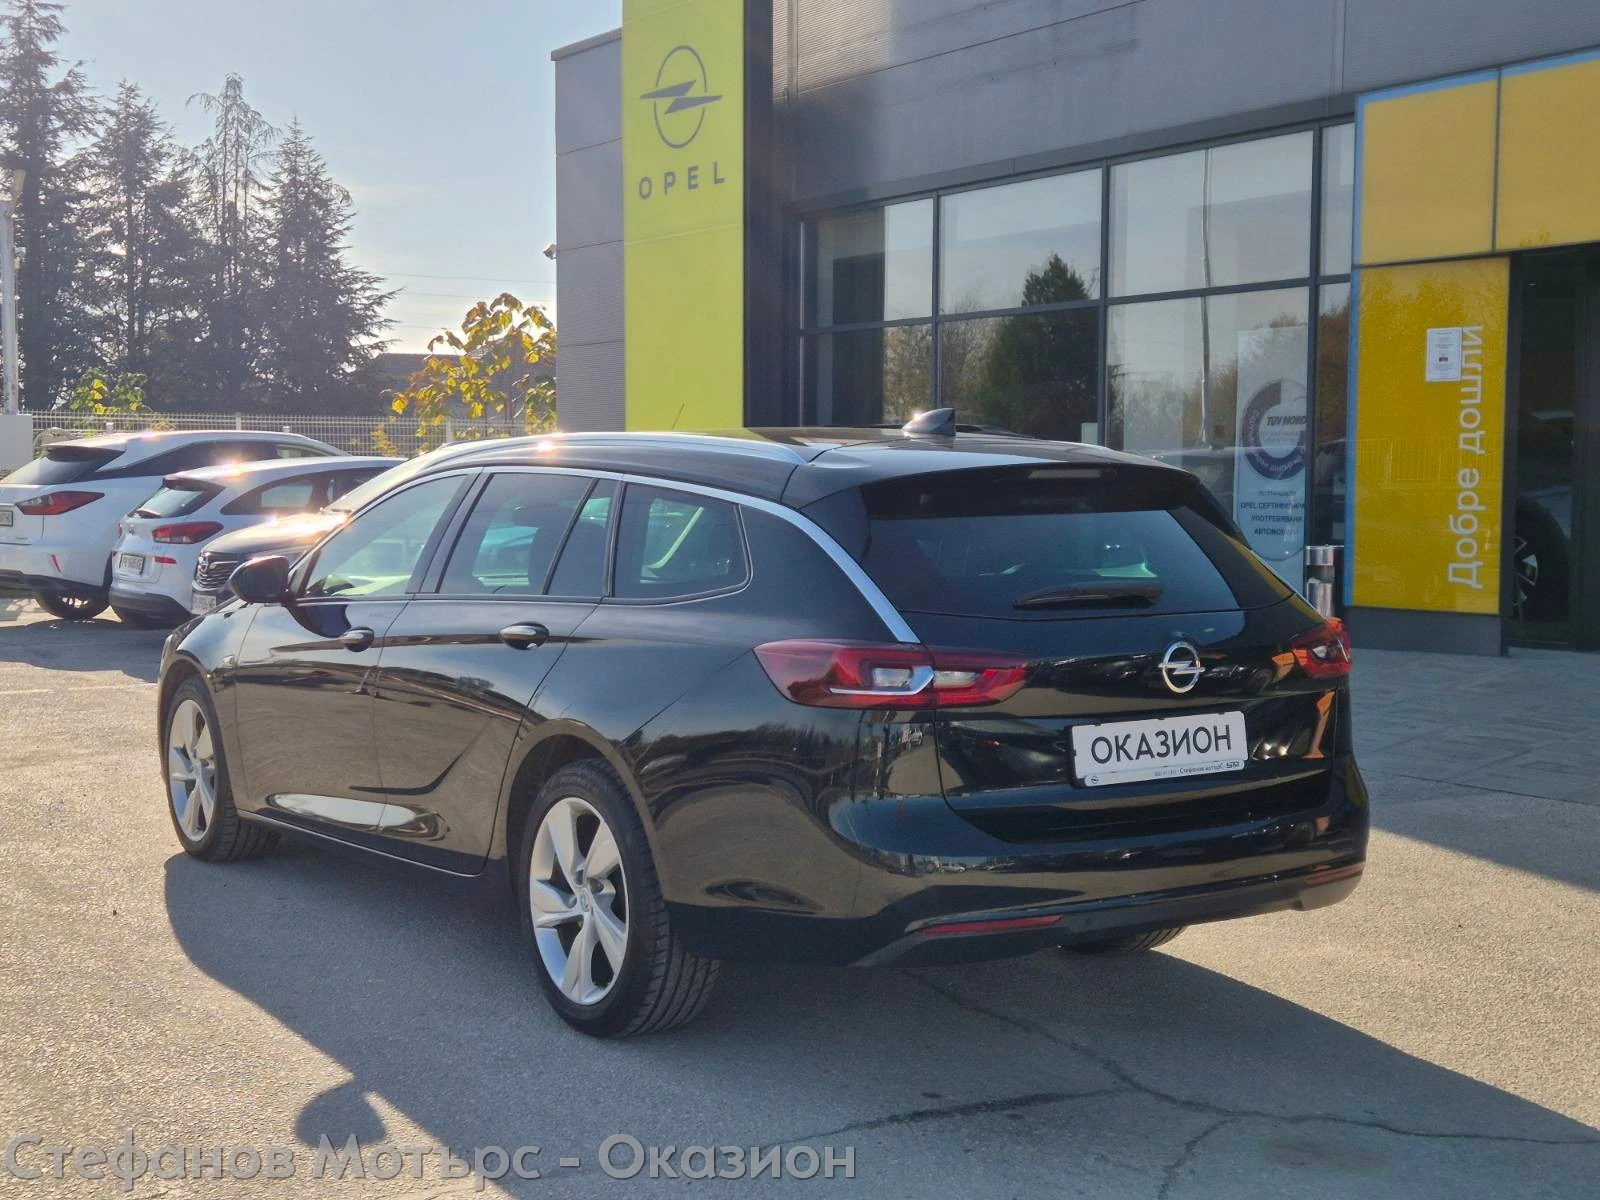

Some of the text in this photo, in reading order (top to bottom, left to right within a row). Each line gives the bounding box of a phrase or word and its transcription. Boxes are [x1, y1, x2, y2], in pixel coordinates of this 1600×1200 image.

[638, 161, 725, 200] OPEL
[1447, 325, 1487, 590] Добре дошли
[1091, 724, 1232, 764] ОКАЗИОН
